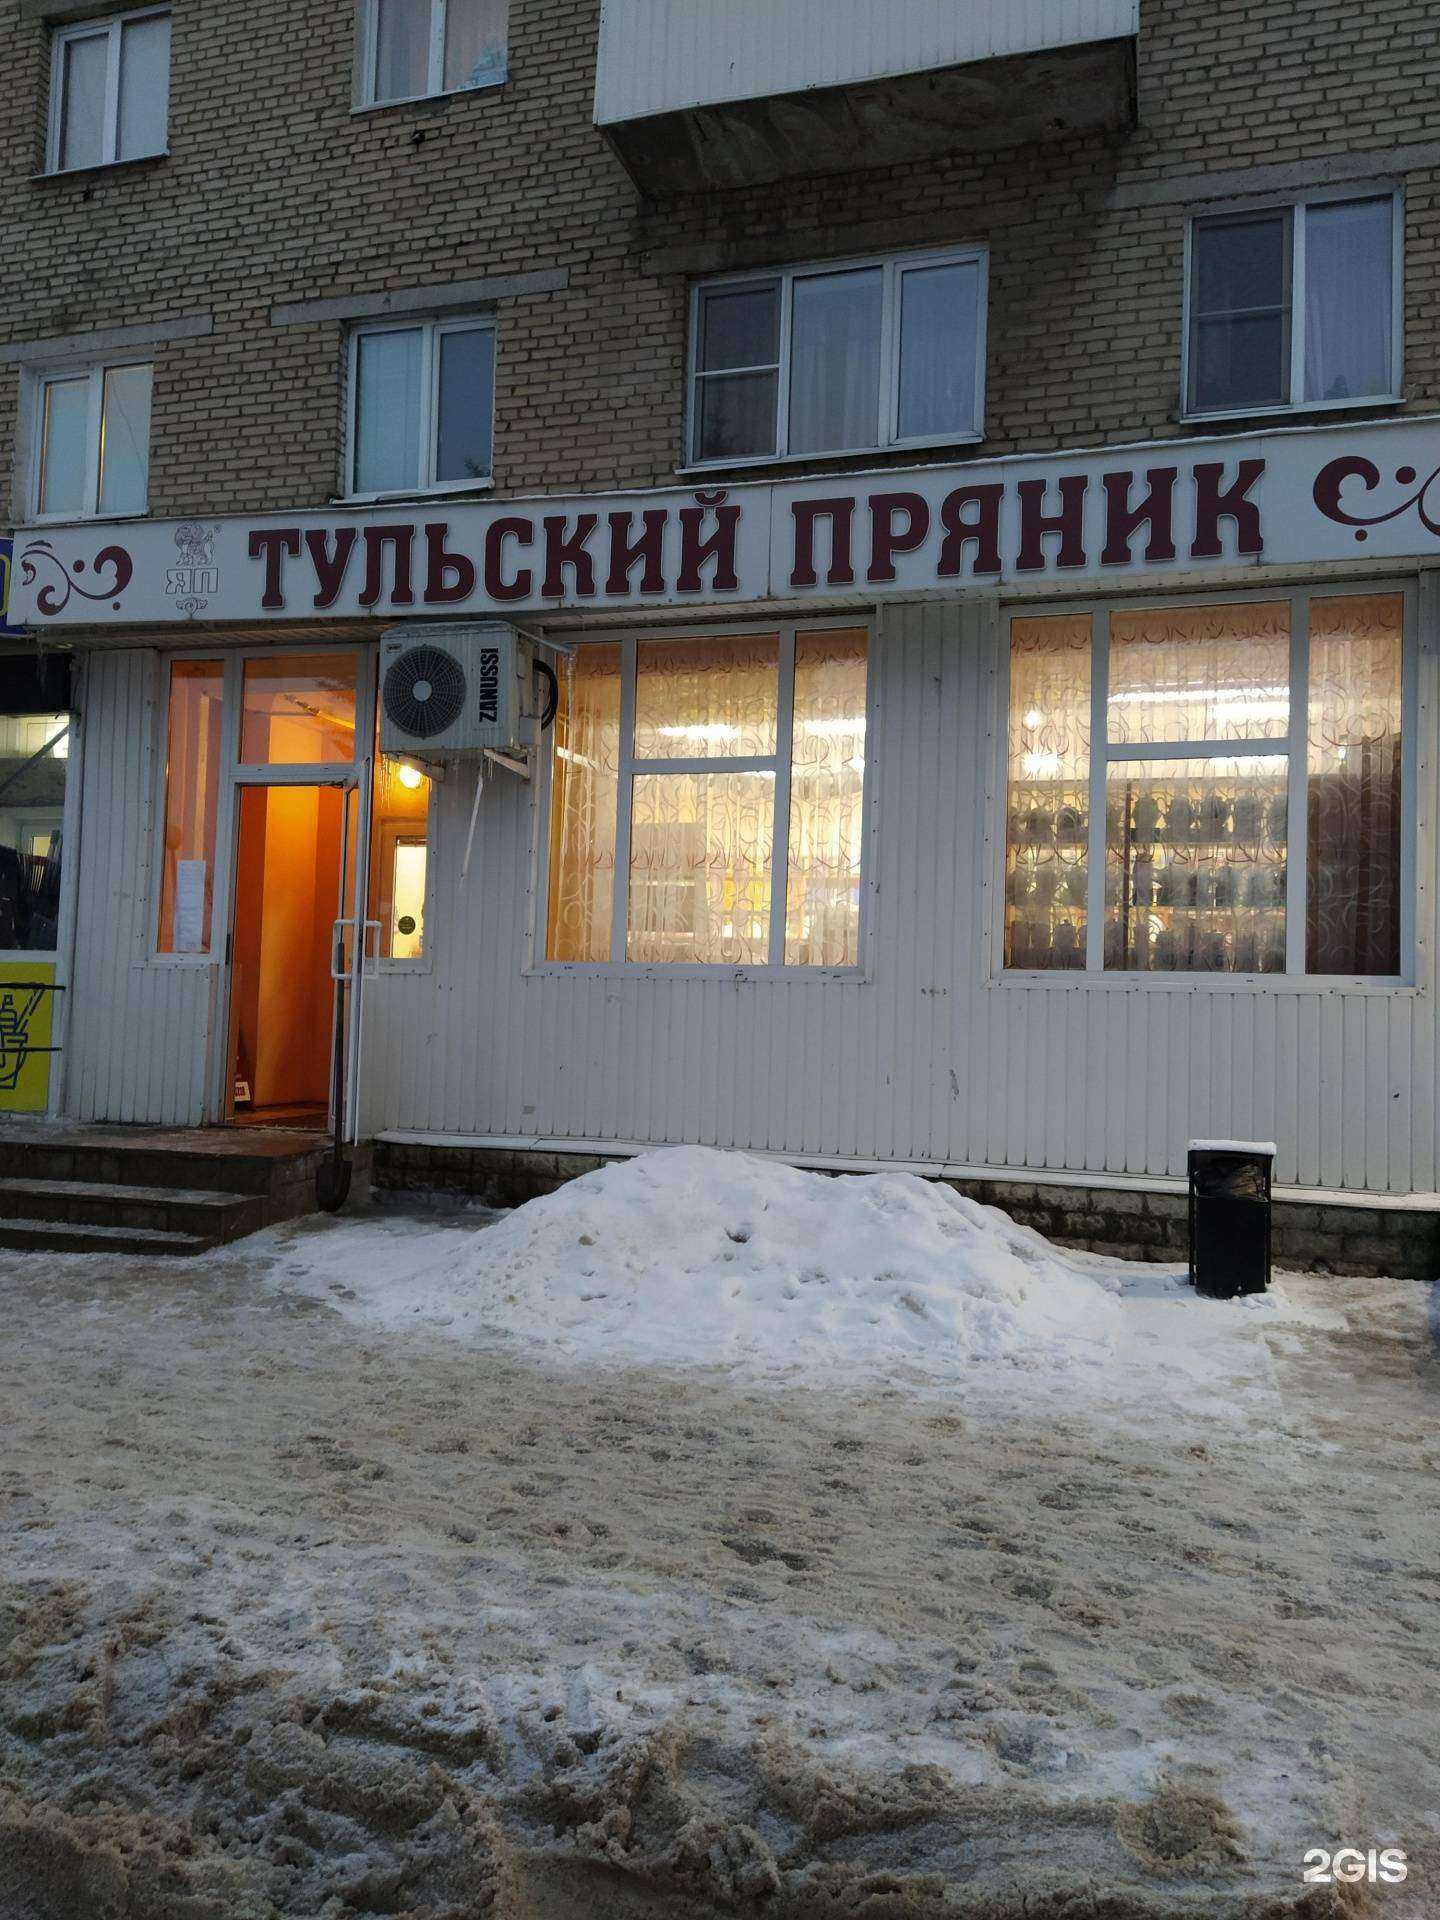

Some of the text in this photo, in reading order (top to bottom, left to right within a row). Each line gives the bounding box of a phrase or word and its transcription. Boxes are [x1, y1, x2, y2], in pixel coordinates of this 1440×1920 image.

[248, 458, 1265, 609] ТУЛЬСКИЙ ПРЯНИК
[479, 647, 499, 723] ZANUSSI
